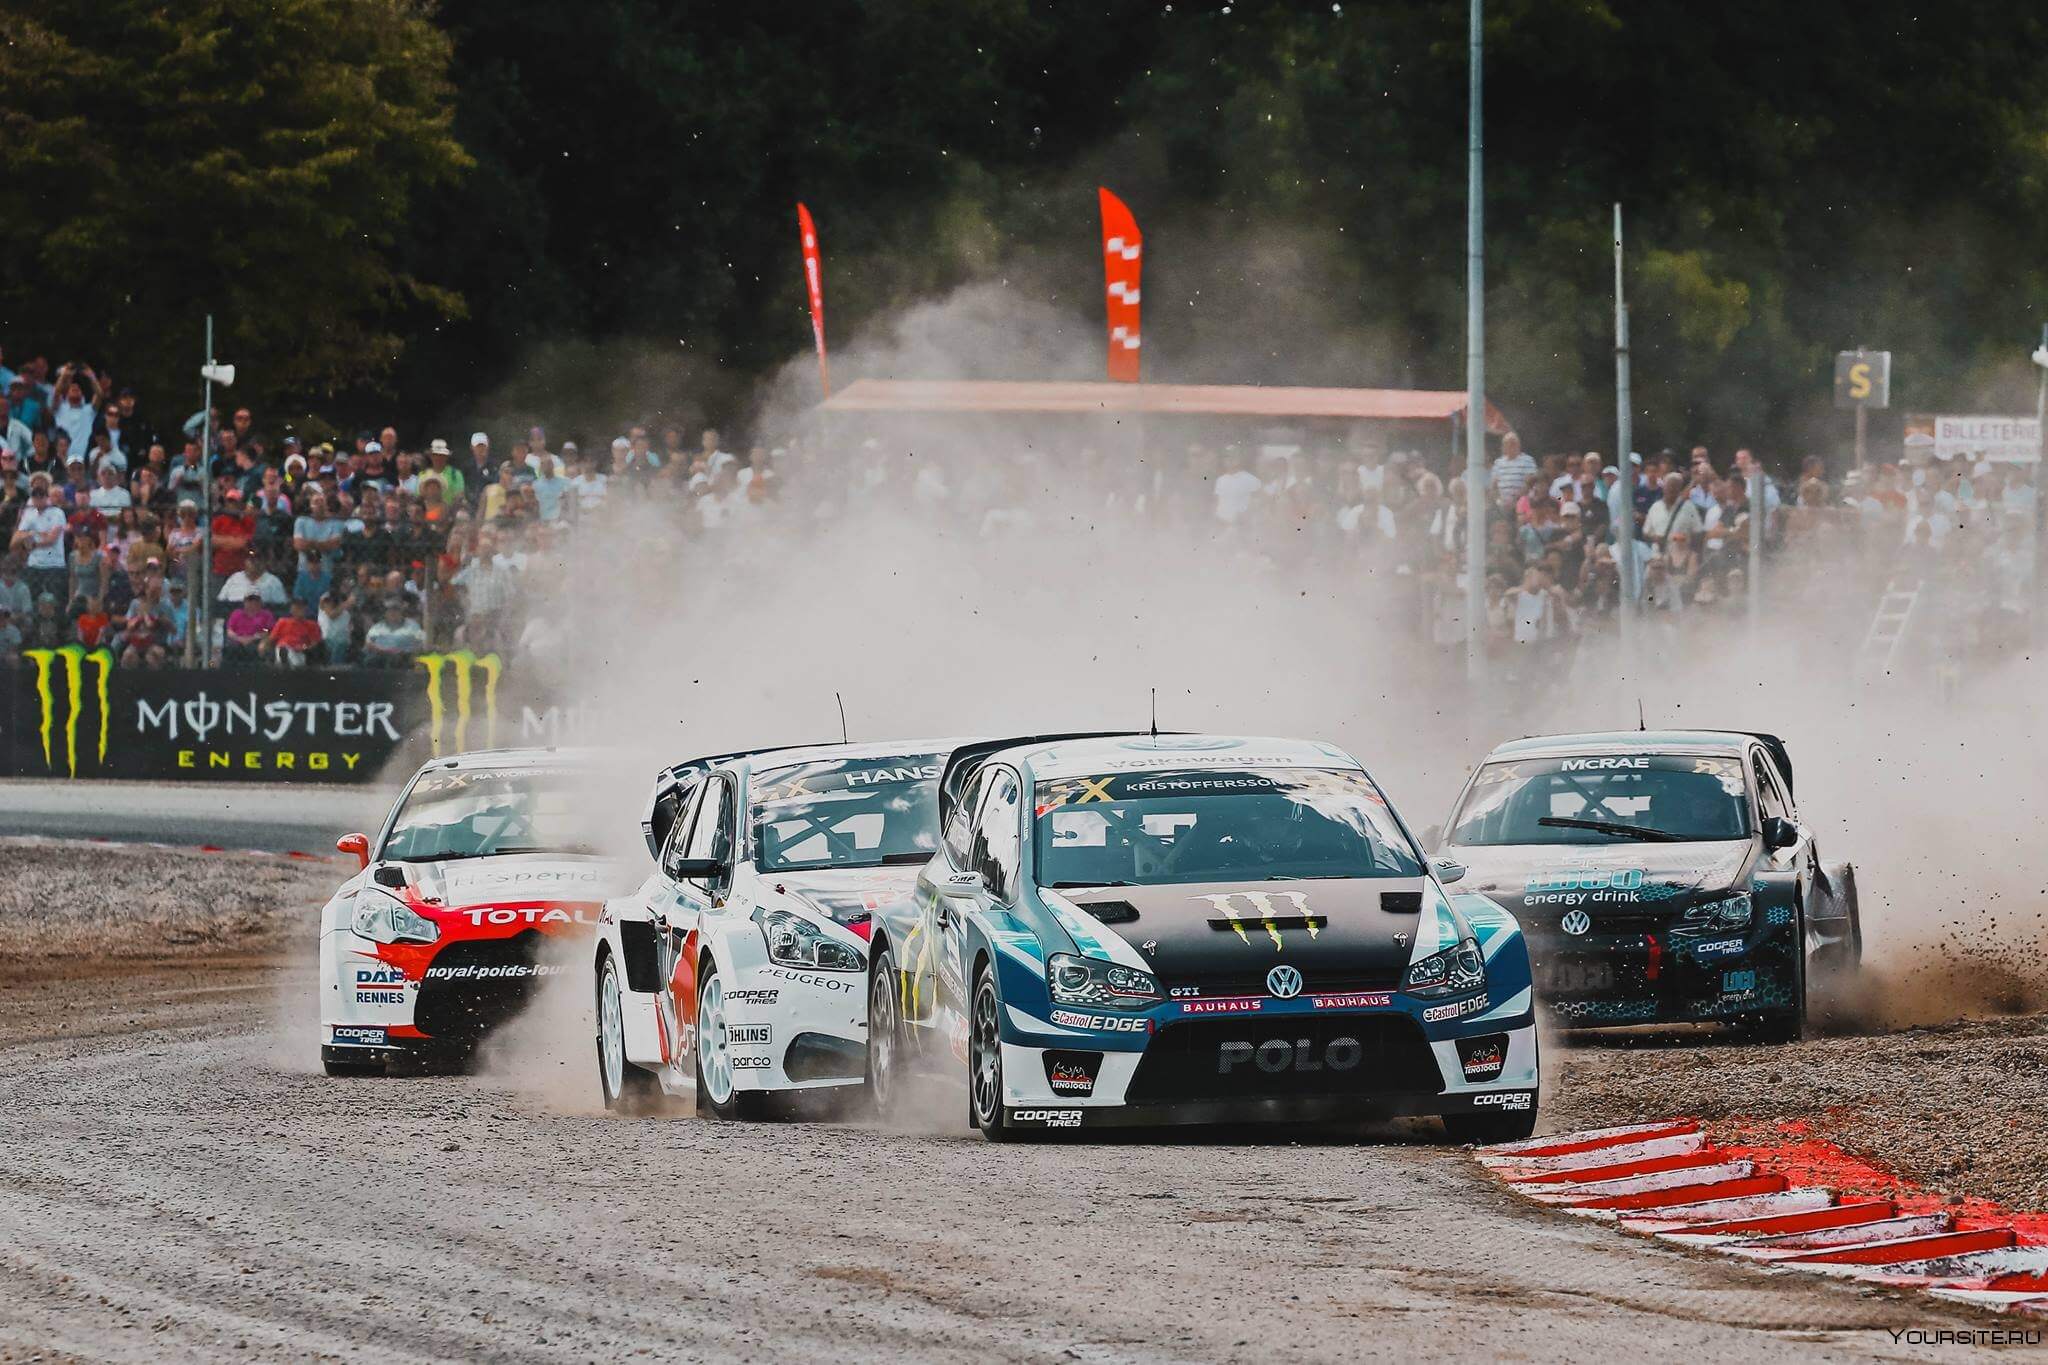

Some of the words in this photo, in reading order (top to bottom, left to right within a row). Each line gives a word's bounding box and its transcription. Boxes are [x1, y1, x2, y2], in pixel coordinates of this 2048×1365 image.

[1849, 363, 1871, 399] S
[137, 691, 401, 742] MONSTER
[178, 750, 361, 771] ENERGY
[472, 773, 494, 781] FIA
[844, 764, 946, 786] HANS
[1524, 891, 1588, 906] energy
[1592, 890, 1641, 903] drink
[463, 907, 597, 927] TOTAL
[1697, 939, 1743, 953] COOPER
[1721, 946, 1744, 955] TIRES
[356, 970, 405, 983] DAF
[759, 968, 855, 994] PEUGEOT
[356, 992, 405, 1004] RENNES
[724, 989, 779, 1001] COOPER
[1170, 987, 1200, 997] GTI
[1183, 1000, 1262, 1012] BAUHAUS
[1313, 994, 1391, 1008] BAUHAUS
[1432, 1003, 1458, 1020] Castrol
[1459, 992, 1490, 1016] EDGE
[1060, 1012, 1089, 1028] Castrol
[1089, 1015, 1149, 1032] EDGE
[336, 1028, 385, 1038] COOPER
[1218, 1037, 1363, 1074] POLO
[733, 1056, 771, 1070] parco
[1473, 1092, 1532, 1106] COOPER
[1501, 1102, 1531, 1111] TIRES
[1013, 1110, 1083, 1121] COOPER
[1045, 1119, 1082, 1127] TIRES
